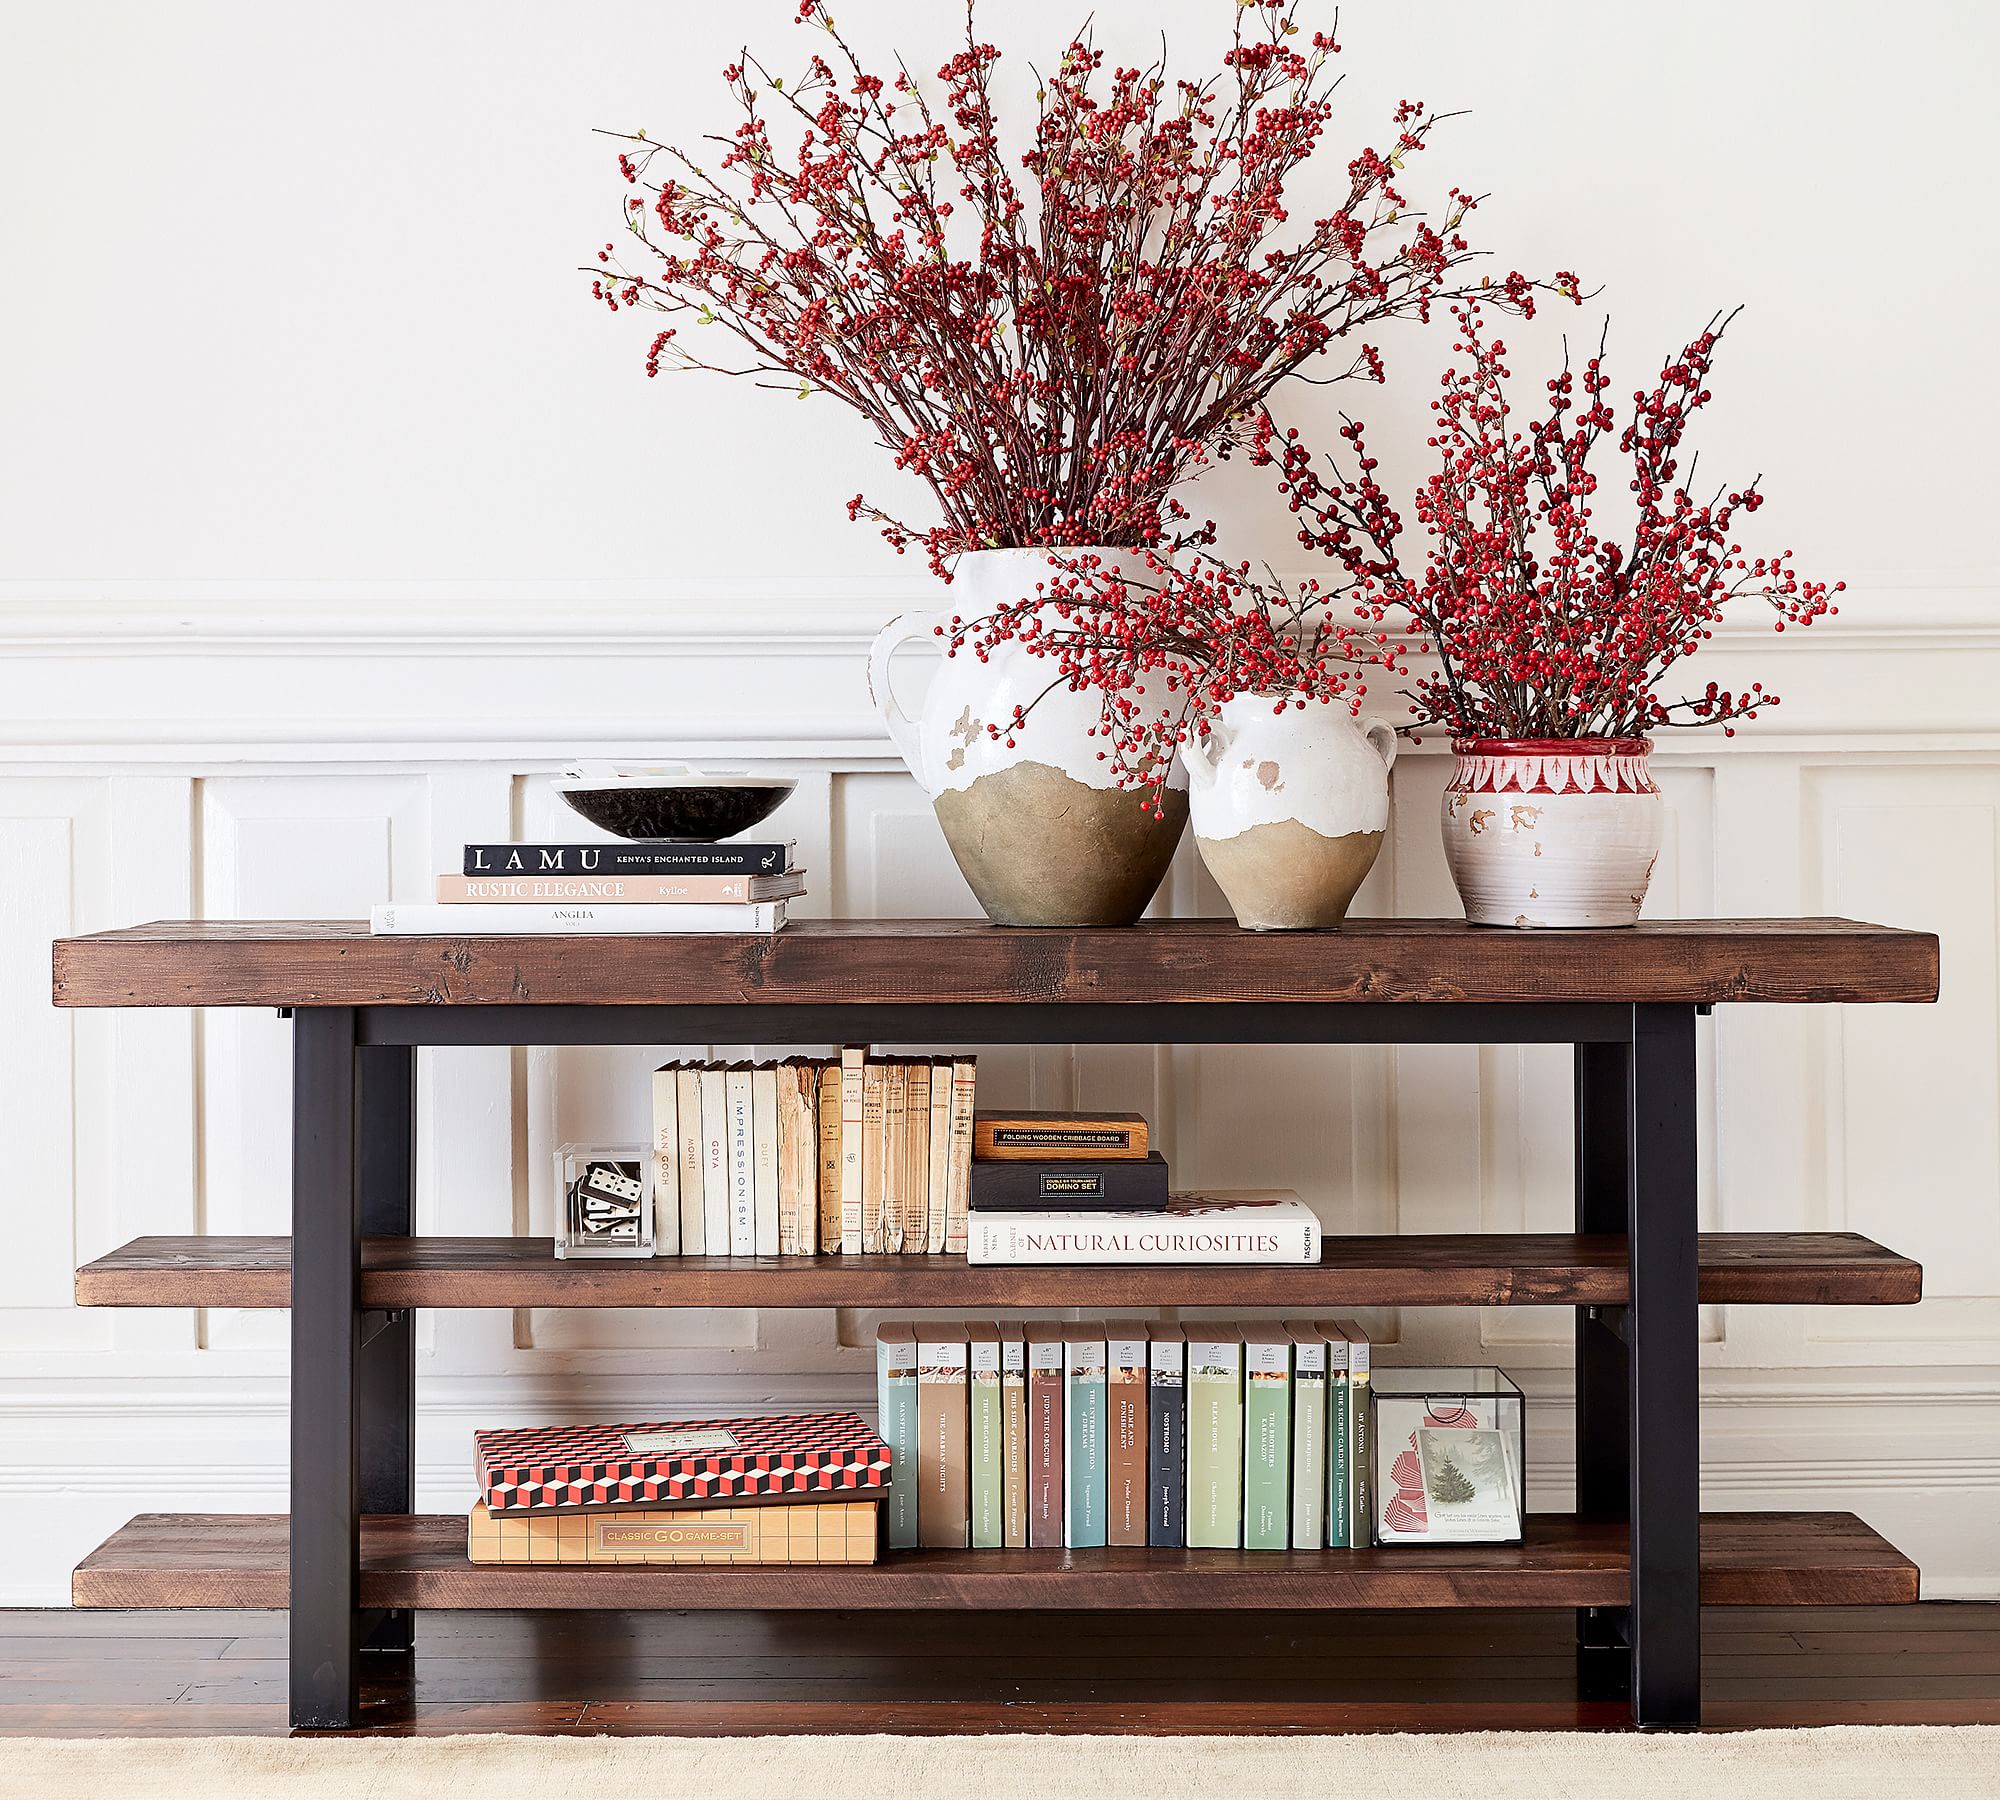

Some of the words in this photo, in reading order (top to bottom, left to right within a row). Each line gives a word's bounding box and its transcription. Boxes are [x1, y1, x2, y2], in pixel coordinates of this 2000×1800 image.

[616, 854, 652, 864] KENYA'S
[654, 854, 709, 864] ENCHANTED
[710, 854, 744, 864] ISLAND
[466, 882, 530, 898] RUSTIC
[533, 882, 625, 898] ELEGANCE
[659, 886, 688, 896] Kylloe
[551, 910, 594, 919] ANGLIA
[660, 1127, 670, 1149] VAN
[1062, 1134, 1096, 1142] CRIBBAGE
[687, 1138, 697, 1170] MONET
[710, 1140, 720, 1169] GOYA
[736, 1100, 746, 1227] IMPRESSIONISM
[761, 1143, 771, 1168] DUFY
[661, 1155, 671, 1186] GOGH
[1018, 1237, 1024, 1248] OF
[1026, 1234, 1136, 1252] NATURAL
[1138, 1234, 1279, 1252] CURIOSITIES
[1303, 1226, 1311, 1260] TASCHEN
[1042, 1394, 1050, 1415] JUDE
[1042, 1415, 1050, 1432] THE
[1358, 1412, 1364, 1422] MY
[1042, 1433, 1050, 1468] OBSCURE
[1042, 1482, 1050, 1503] Thomas
[1124, 1479, 1132, 1499] Fyodor
[1162, 1485, 1170, 1506] Joseph
[898, 1494, 906, 1506] Jane
[1304, 1503, 1312, 1517] Jane
[1010, 1507, 1018, 1537] Fitzgerald
[607, 1532, 652, 1541] CLASSIC
[654, 1530, 683, 1542] GO
[685, 1532, 742, 1541] GAME-SET
